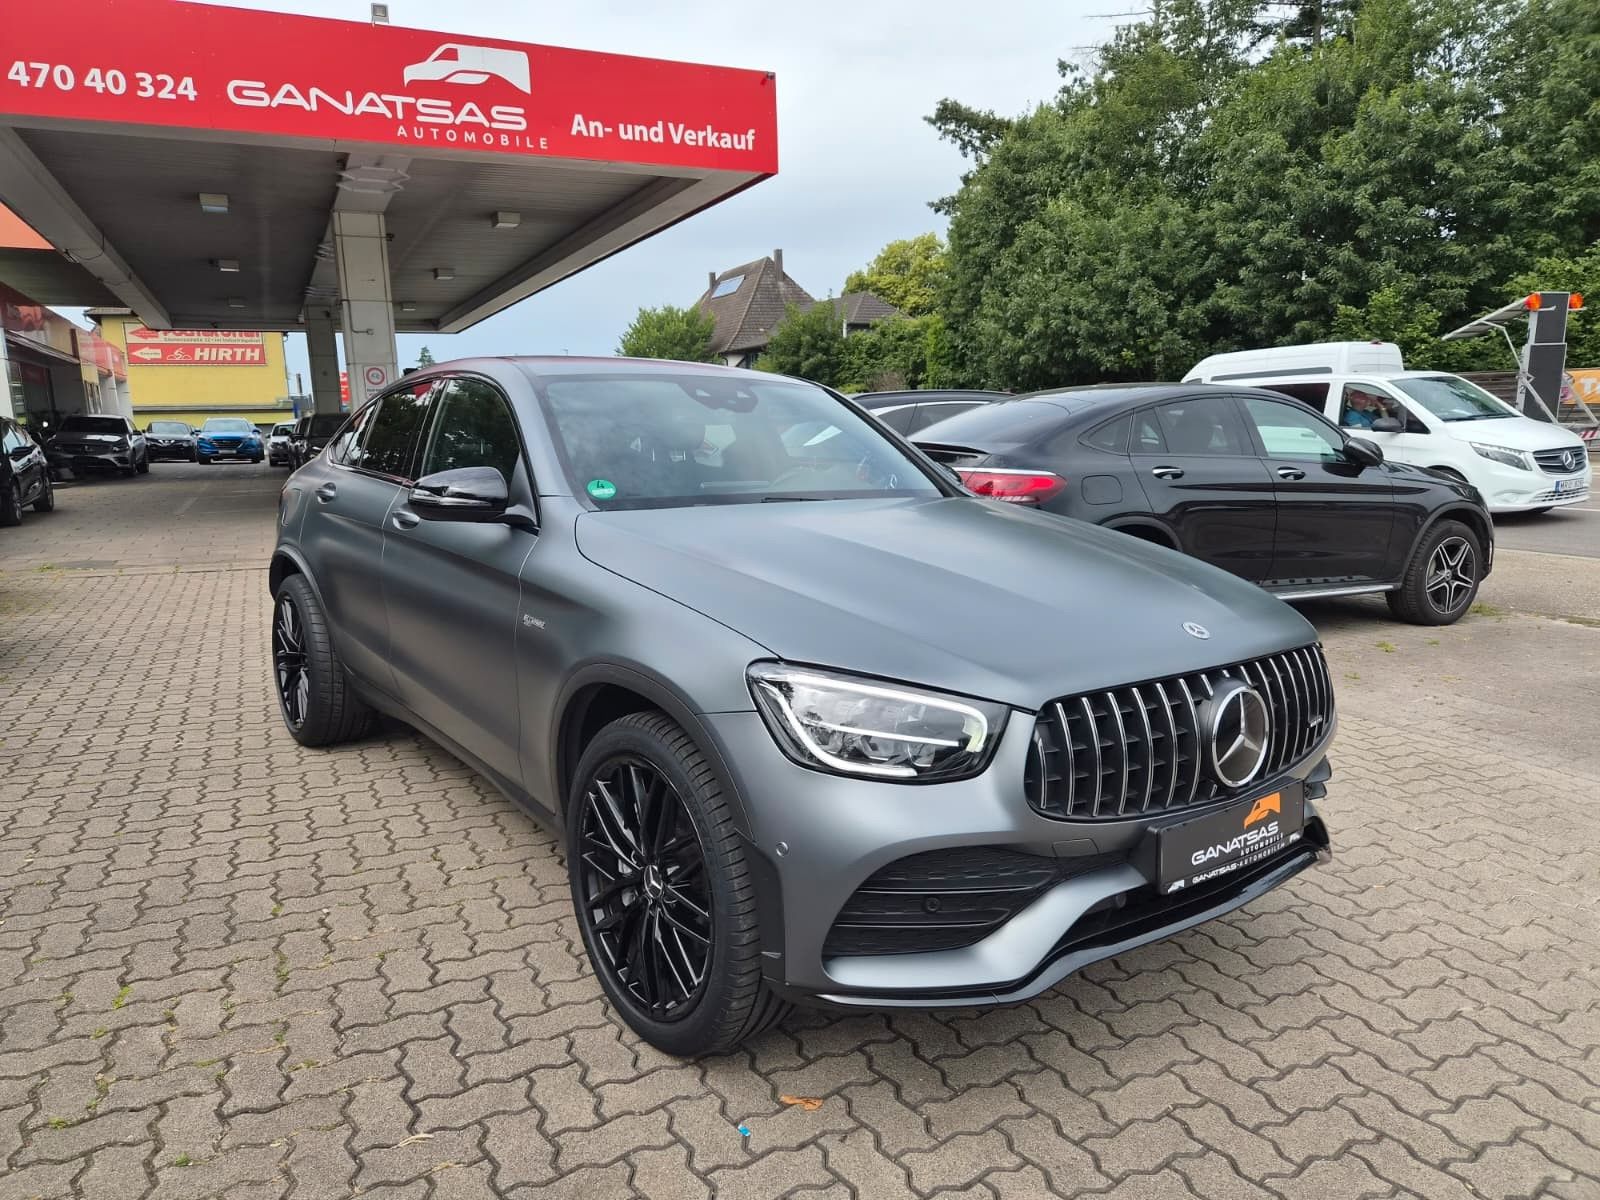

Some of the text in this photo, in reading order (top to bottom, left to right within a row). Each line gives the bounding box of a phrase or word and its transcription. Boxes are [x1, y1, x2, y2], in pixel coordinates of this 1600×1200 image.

[8, 60, 198, 101] 470 40 324
[226, 79, 528, 131] GANATSAS
[396, 125, 549, 149] AUTOMOBILE
[570, 113, 755, 150] An- und Verkauf
[194, 347, 261, 361] HIRTH
[1191, 820, 1279, 866] GANATSAS
